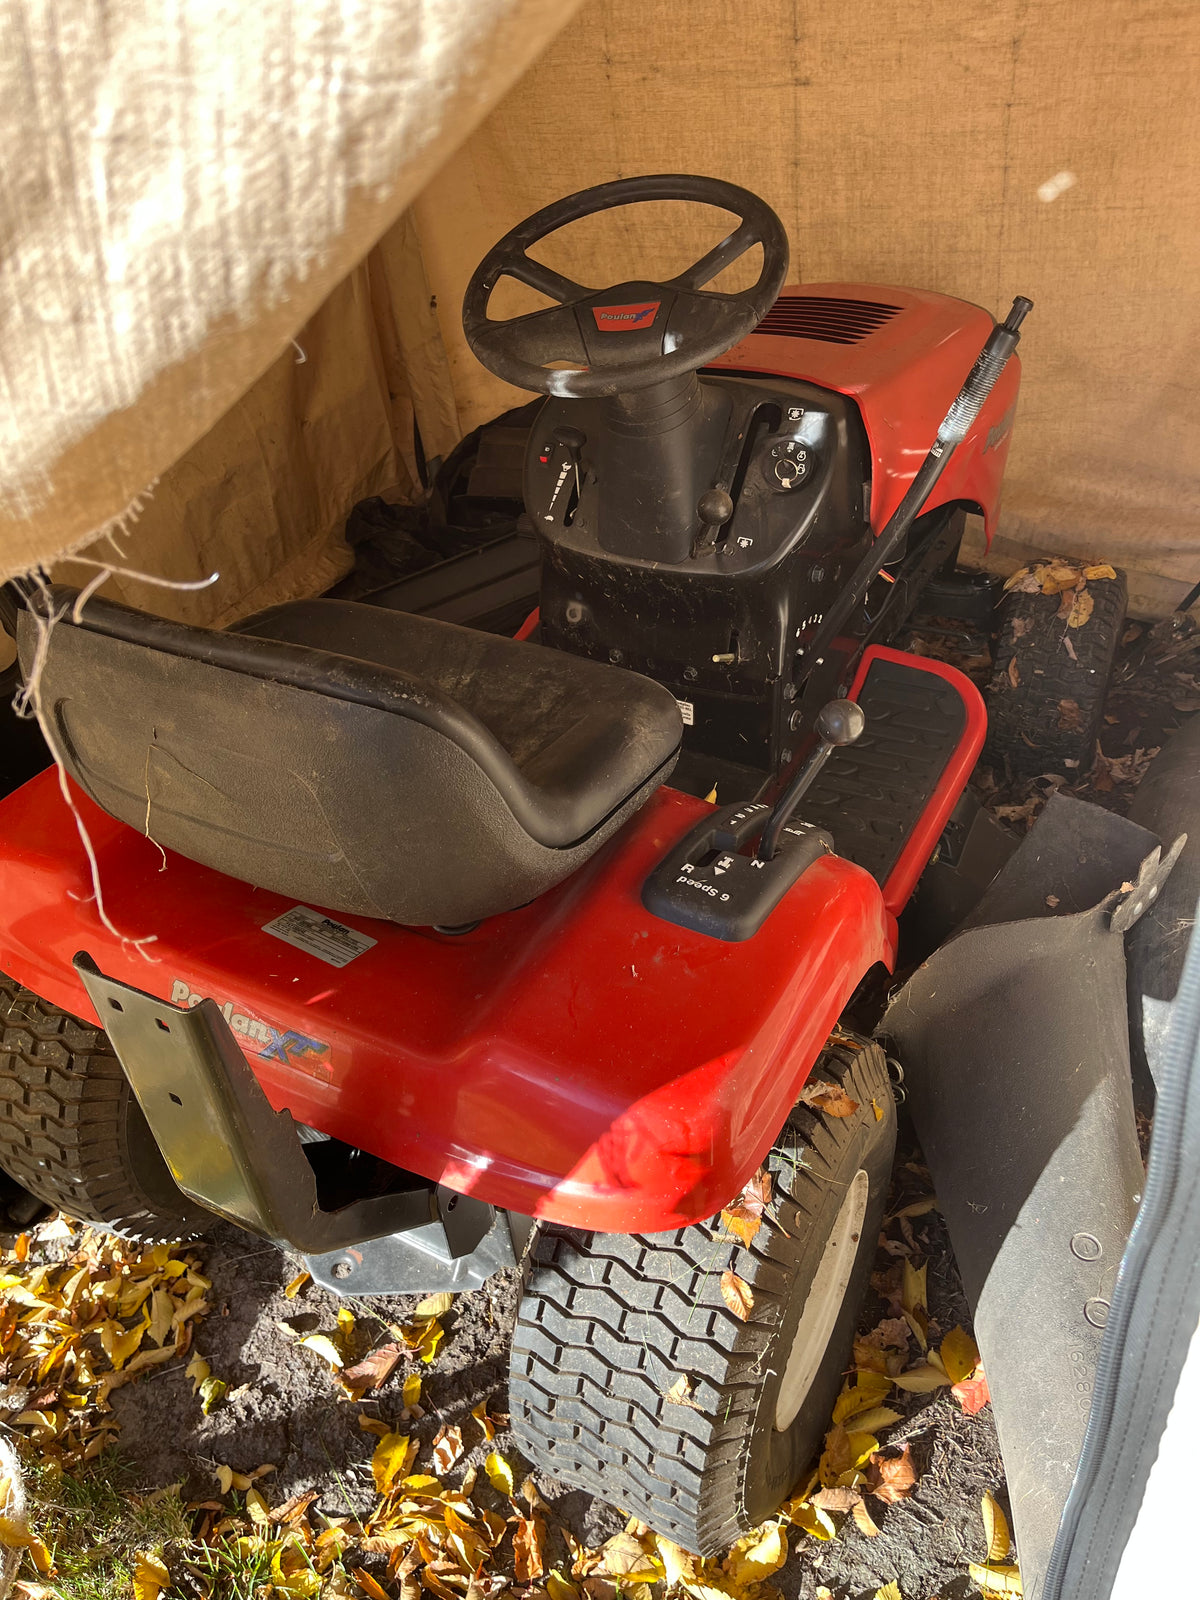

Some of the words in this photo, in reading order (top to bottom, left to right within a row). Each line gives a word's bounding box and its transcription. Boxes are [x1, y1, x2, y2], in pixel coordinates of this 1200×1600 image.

[600, 312, 637, 321] Poulan
[680, 863, 696, 874] R
[750, 859, 765, 869] N
[676, 876, 719, 897] Speed
[719, 893, 730, 902] 6
[322, 918, 350, 935] Poulan
[171, 979, 272, 1044] Polan
